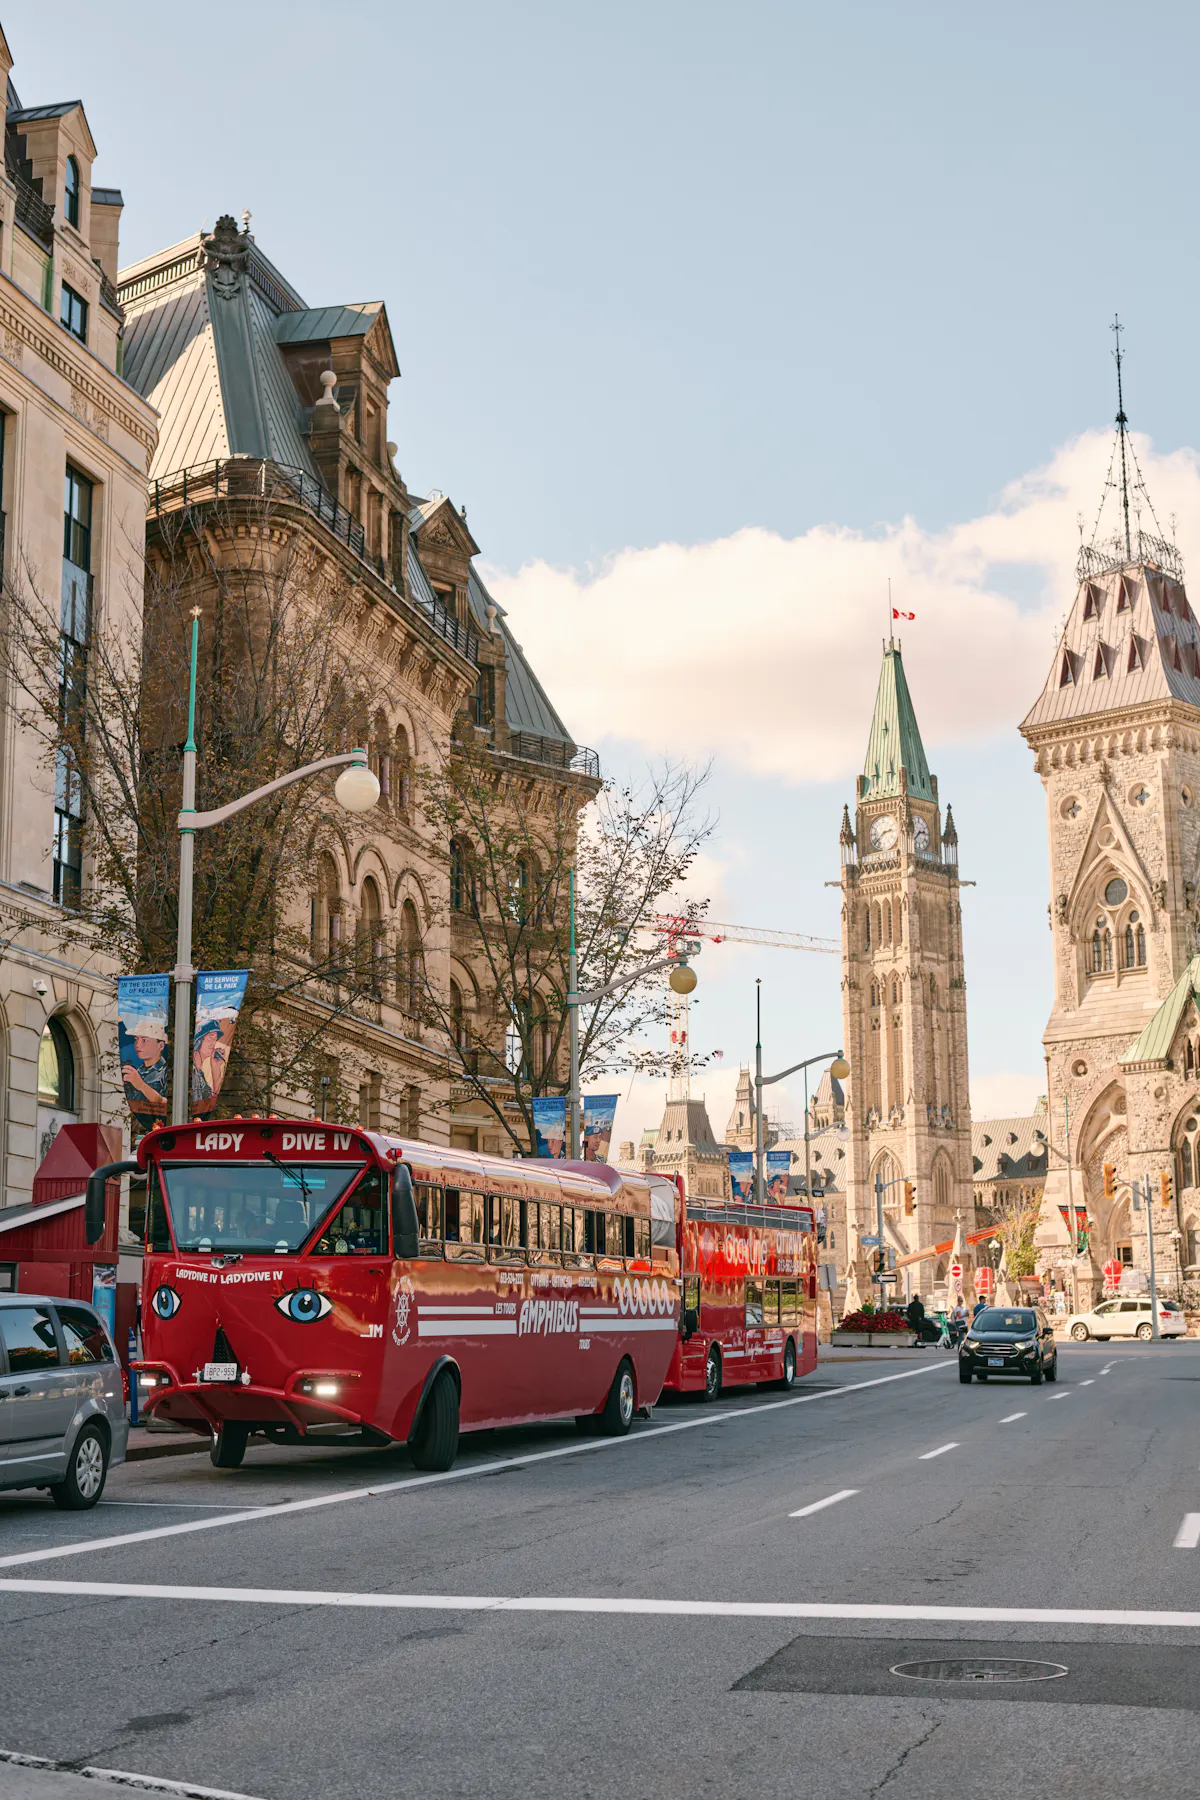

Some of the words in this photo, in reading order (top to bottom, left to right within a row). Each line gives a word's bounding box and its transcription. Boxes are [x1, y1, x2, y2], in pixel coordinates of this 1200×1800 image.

[141, 980, 167, 988] SERVICE
[195, 1132, 245, 1152] LADY
[282, 1133, 326, 1151] DIVE
[333, 1133, 353, 1151] IV
[175, 1267, 208, 1283] LADYDIVE
[209, 1274, 218, 1284] IV
[220, 1271, 271, 1285] LADYDIVE
[272, 1270, 284, 1281] IV
[503, 1302, 517, 1315] TOURS
[518, 1300, 579, 1338] AMPHIBUS
